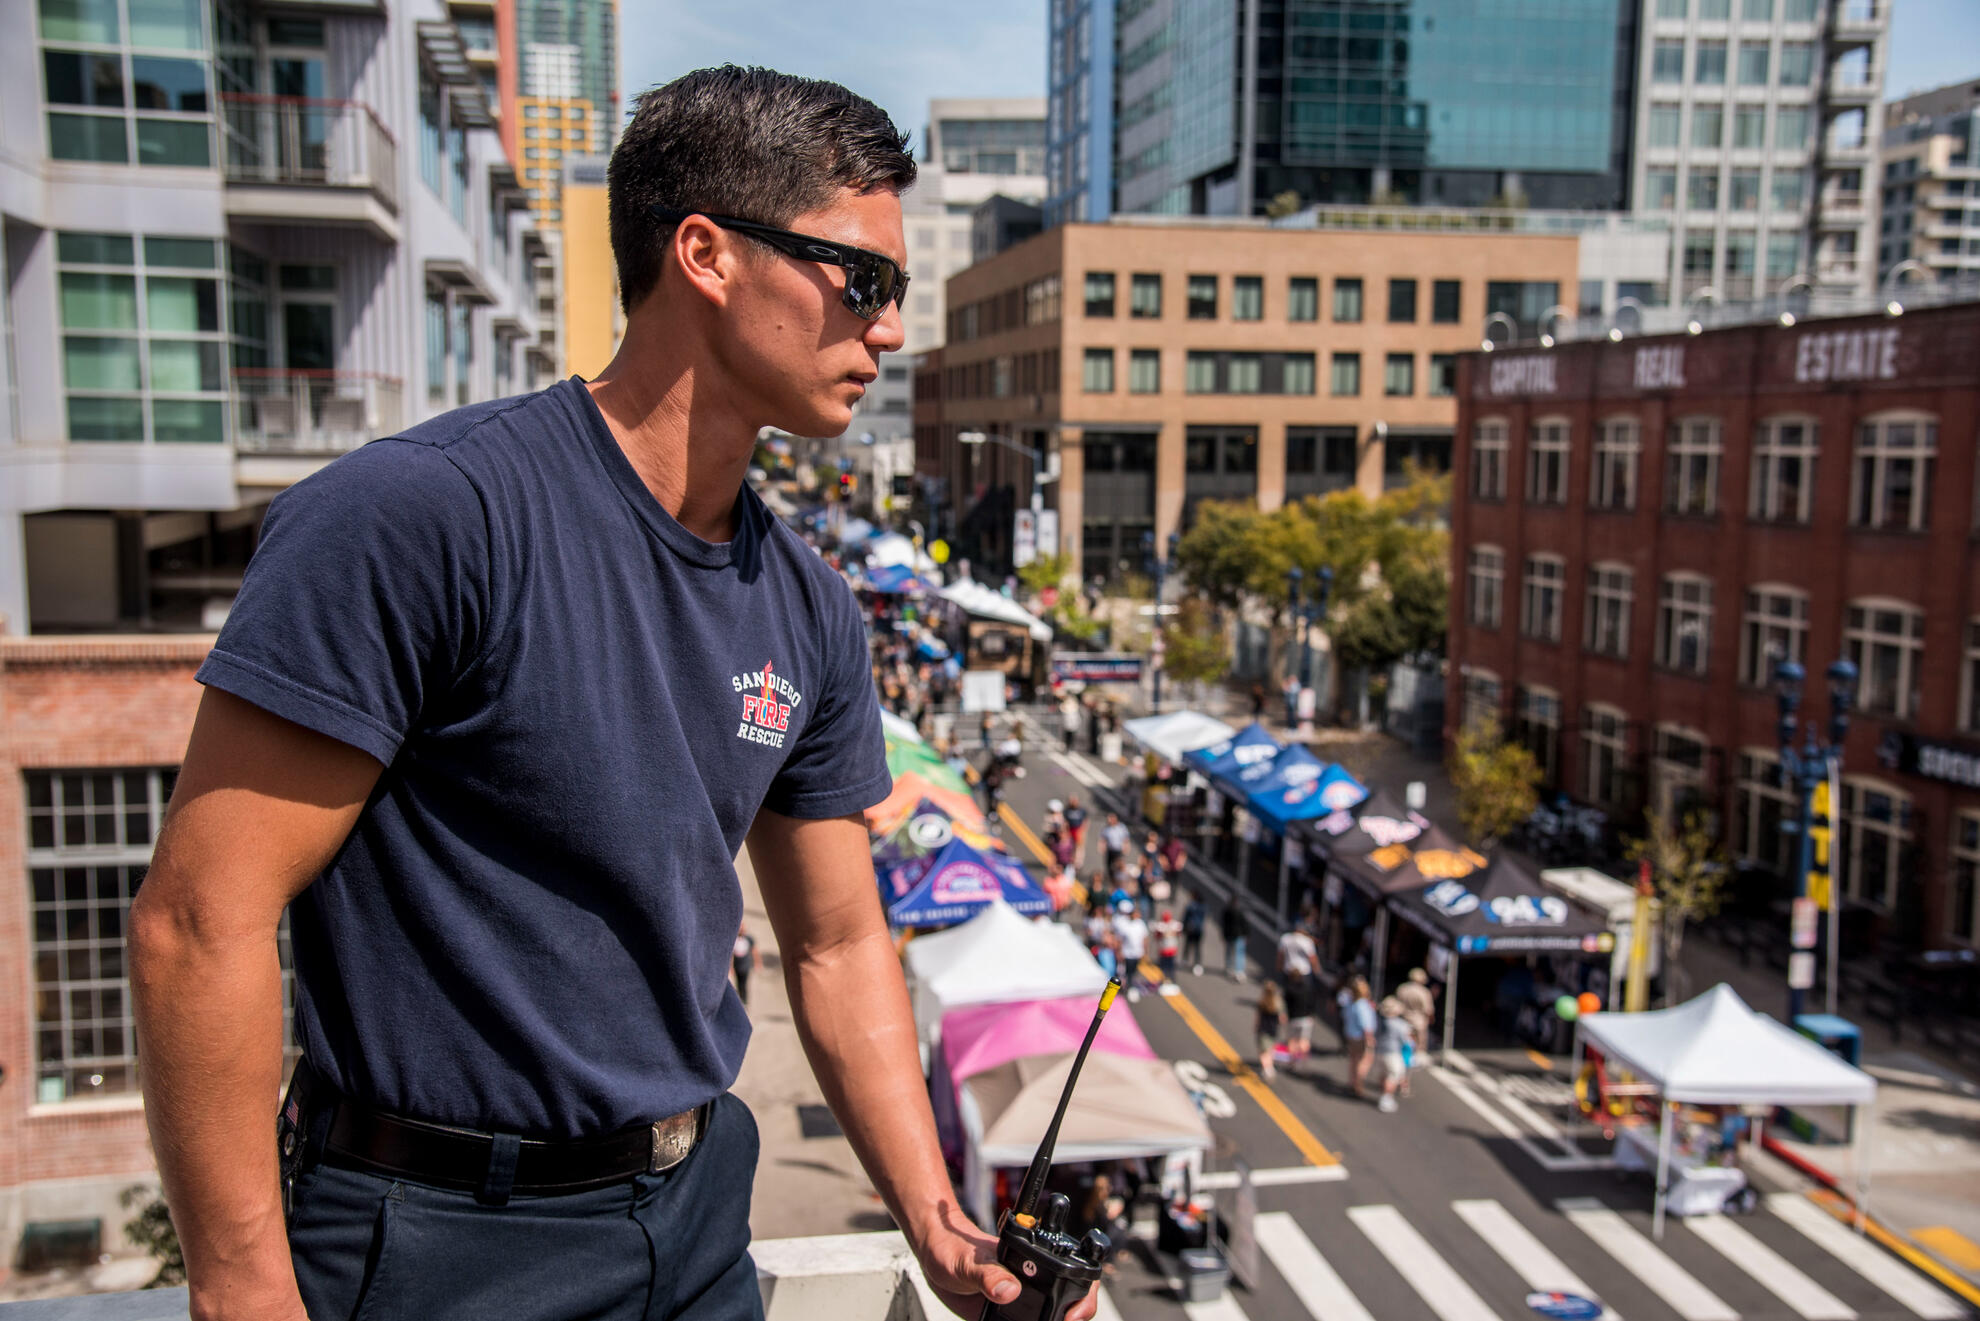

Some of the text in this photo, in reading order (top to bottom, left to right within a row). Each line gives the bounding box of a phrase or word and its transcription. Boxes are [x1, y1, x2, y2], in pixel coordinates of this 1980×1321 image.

[1634, 345, 1686, 388] REAL
[1796, 328, 1901, 381] ESTATE
[732, 672, 802, 708] SAN DIEGO
[742, 694, 791, 732] FIRE
[736, 722, 785, 748] RESCUE
